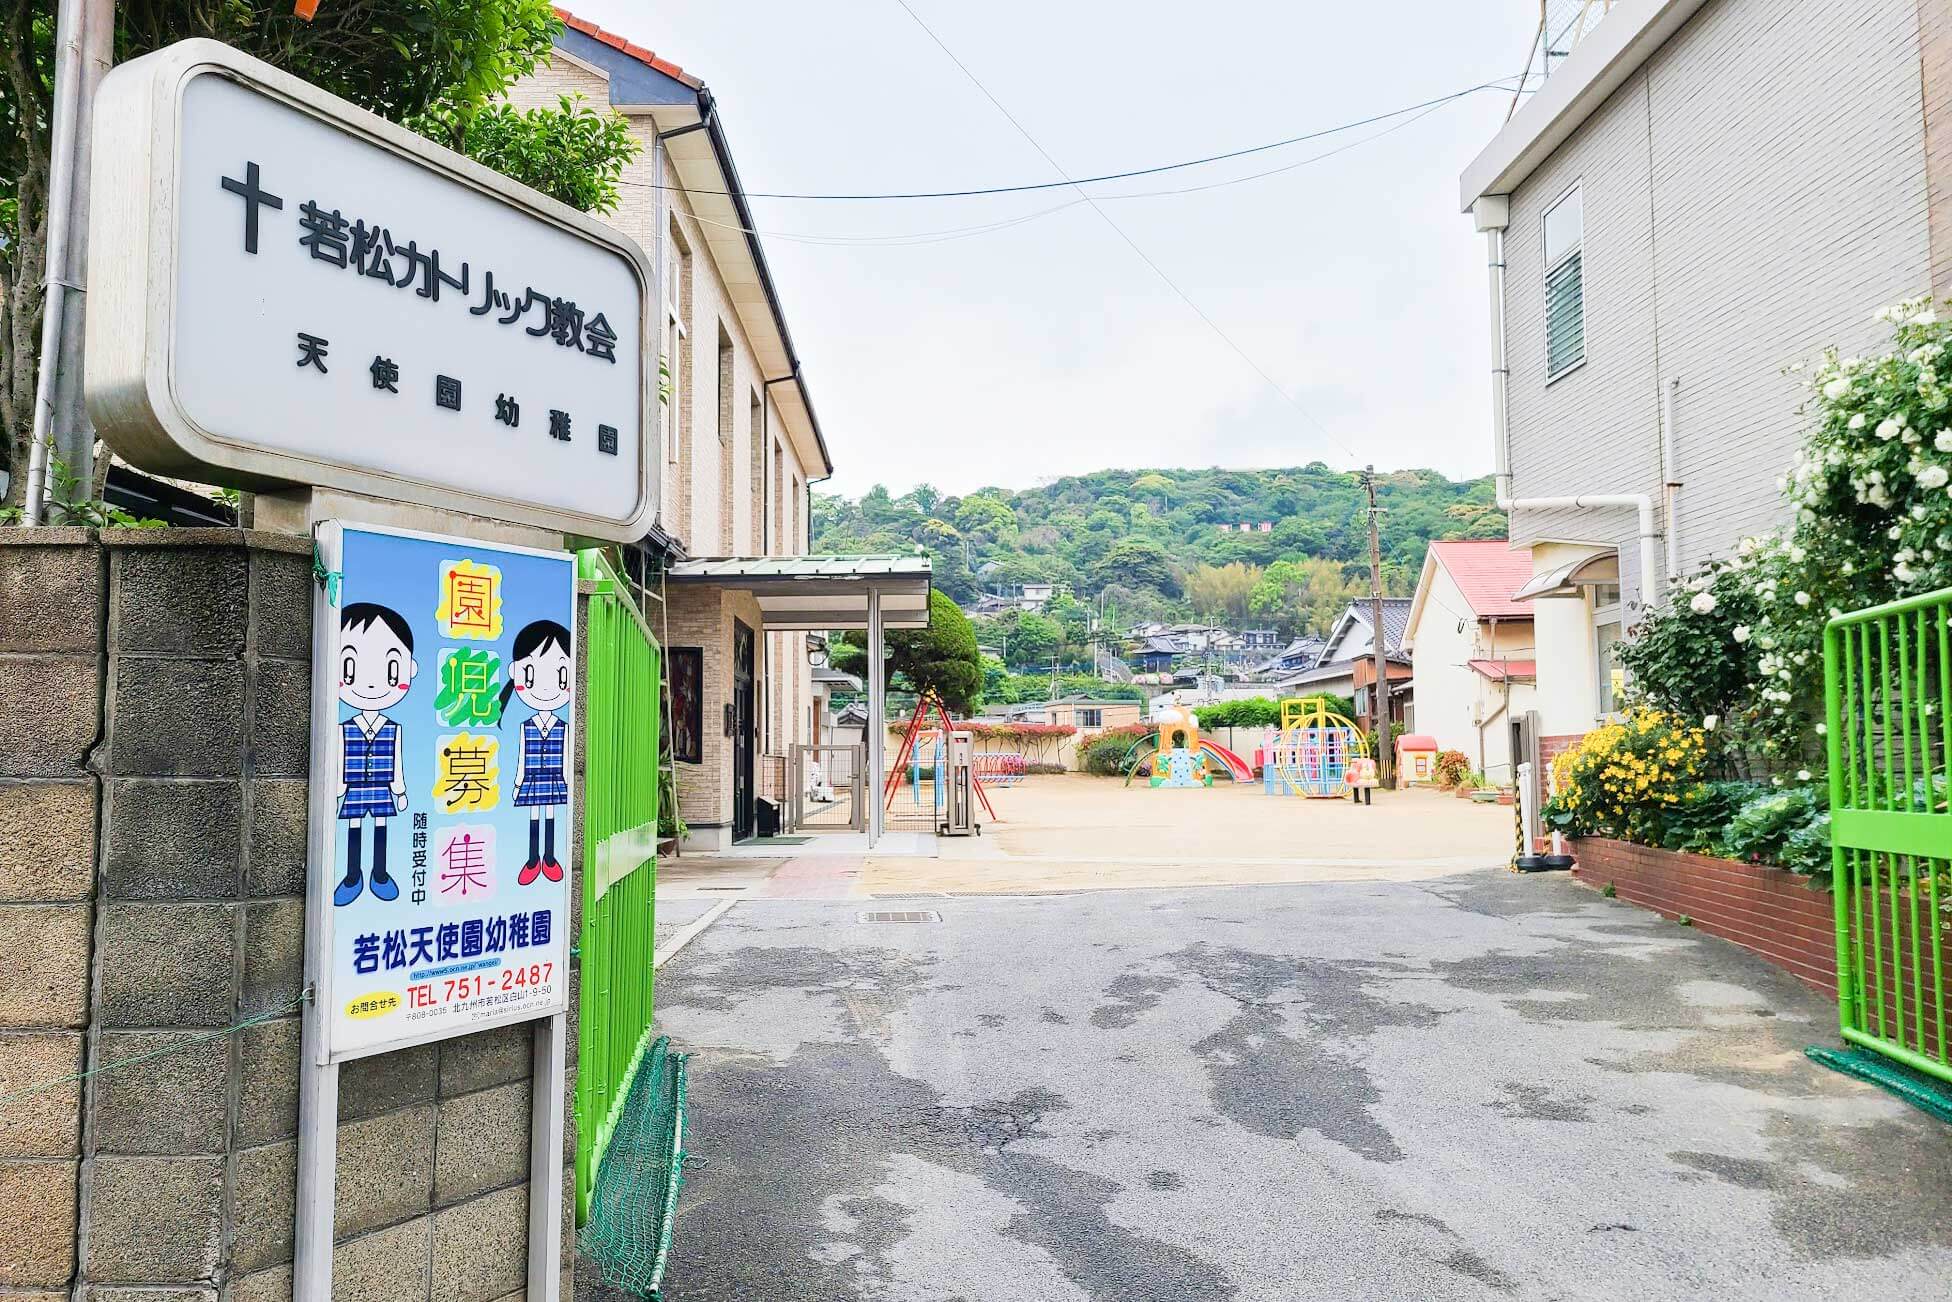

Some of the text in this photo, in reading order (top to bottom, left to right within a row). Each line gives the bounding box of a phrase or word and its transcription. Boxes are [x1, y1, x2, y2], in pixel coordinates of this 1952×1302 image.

[299, 200, 617, 364] 若松カトリック教会
[296, 332, 618, 456] 天使園幼稚園
[441, 570, 492, 895] 園児募集
[411, 812, 428, 905] 随時受付中
[353, 909, 552, 975] 若松天使園幼稚園
[407, 963, 553, 1008] TEL 751-2487
[350, 997, 397, 1015] お問合せ先
